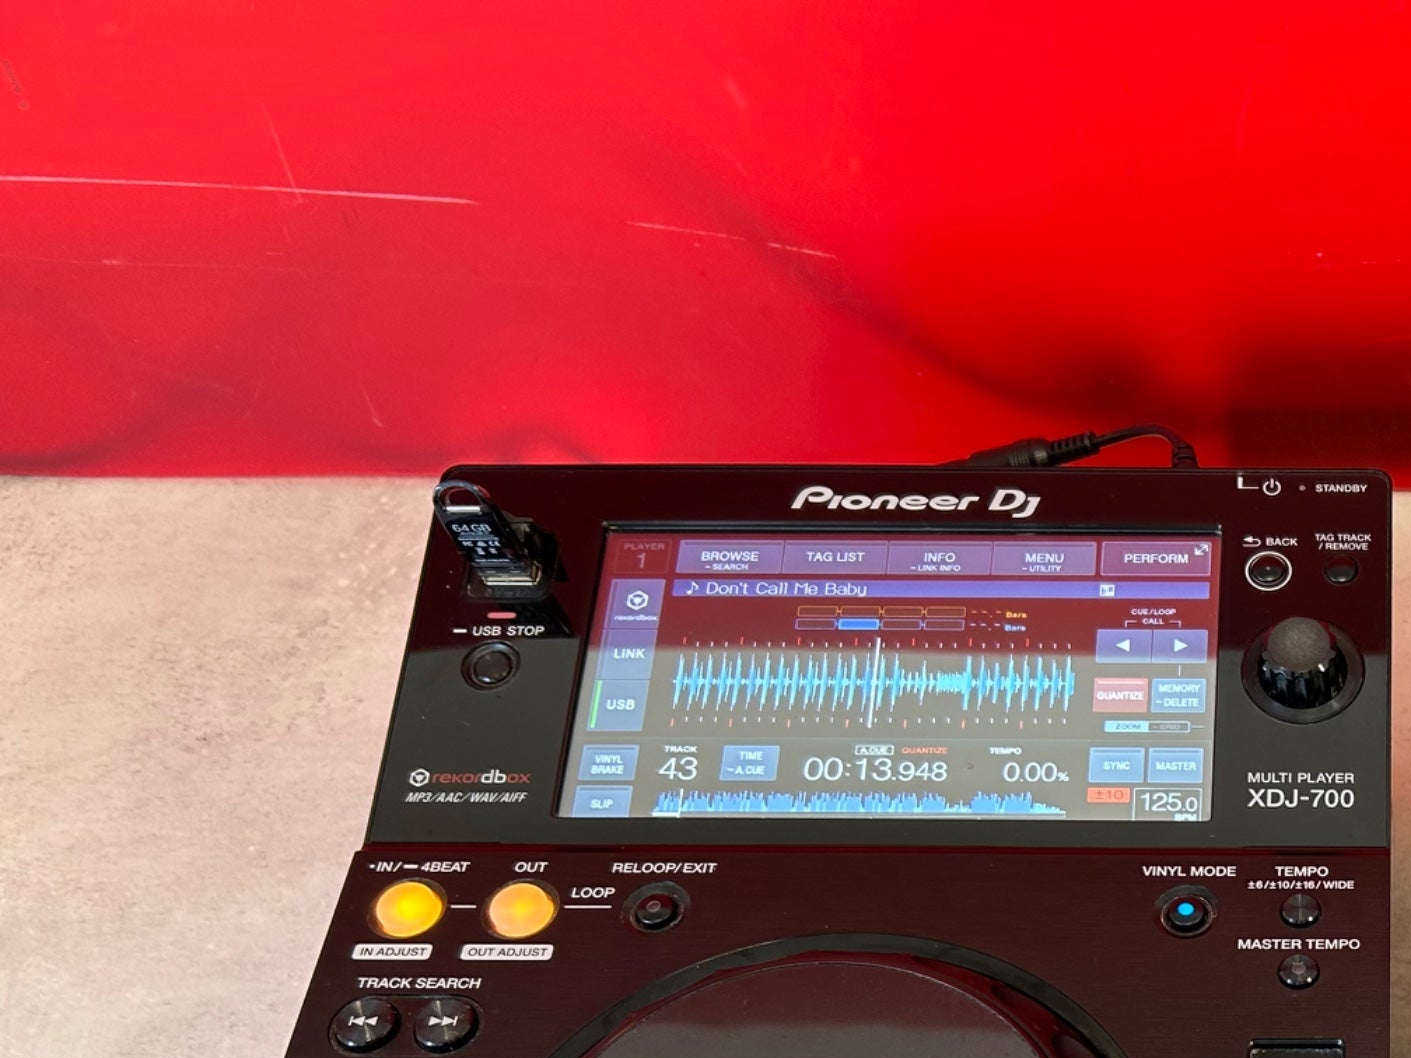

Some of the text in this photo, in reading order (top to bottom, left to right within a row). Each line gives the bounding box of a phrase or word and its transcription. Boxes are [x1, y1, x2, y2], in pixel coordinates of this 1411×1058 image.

[1315, 484, 1367, 493] STANDBY
[790, 485, 980, 511] Pioneer
[1266, 538, 1298, 546] BACK
[637, 552, 645, 569] 1
[701, 551, 759, 562] BROWSE
[807, 552, 865, 562] TAG LIST
[924, 552, 956, 563] INFO
[1025, 553, 1064, 563] MENU
[1124, 553, 1189, 564] PERFORM
[706, 581, 868, 598] Don't Call Me Baby
[472, 626, 545, 636] USB STOP
[614, 649, 645, 659] LINK
[1158, 684, 1200, 693] MEMORY
[1097, 691, 1144, 700] QUANTIZE
[606, 700, 635, 710] USB
[739, 751, 763, 761] TIME
[989, 747, 1022, 755] TEMPO
[595, 754, 623, 764] VINYL
[591, 765, 624, 775] BRAKE
[658, 757, 698, 781] 43
[803, 757, 948, 782] 00:13.948
[1103, 761, 1131, 771] SYNC
[1155, 761, 1197, 771] MASTER
[432, 769, 531, 784] rekordbox
[1247, 773, 1355, 784] MULTI PLAYER
[591, 799, 614, 809] SLIP
[1140, 792, 1198, 811] 125.0
[1247, 789, 1355, 808] XDJ-700
[421, 862, 470, 873] 4BEAT
[515, 862, 548, 873] OUT
[1142, 866, 1237, 877] VINYL MODE
[1275, 866, 1329, 877] TEMPO
[571, 887, 615, 899] LOOP
[1237, 939, 1361, 950] MASTER TEMPO
[359, 947, 428, 957] IN ADJUST
[468, 947, 548, 957] OUT ADJUST
[358, 977, 482, 989] TRACK SEARCH
